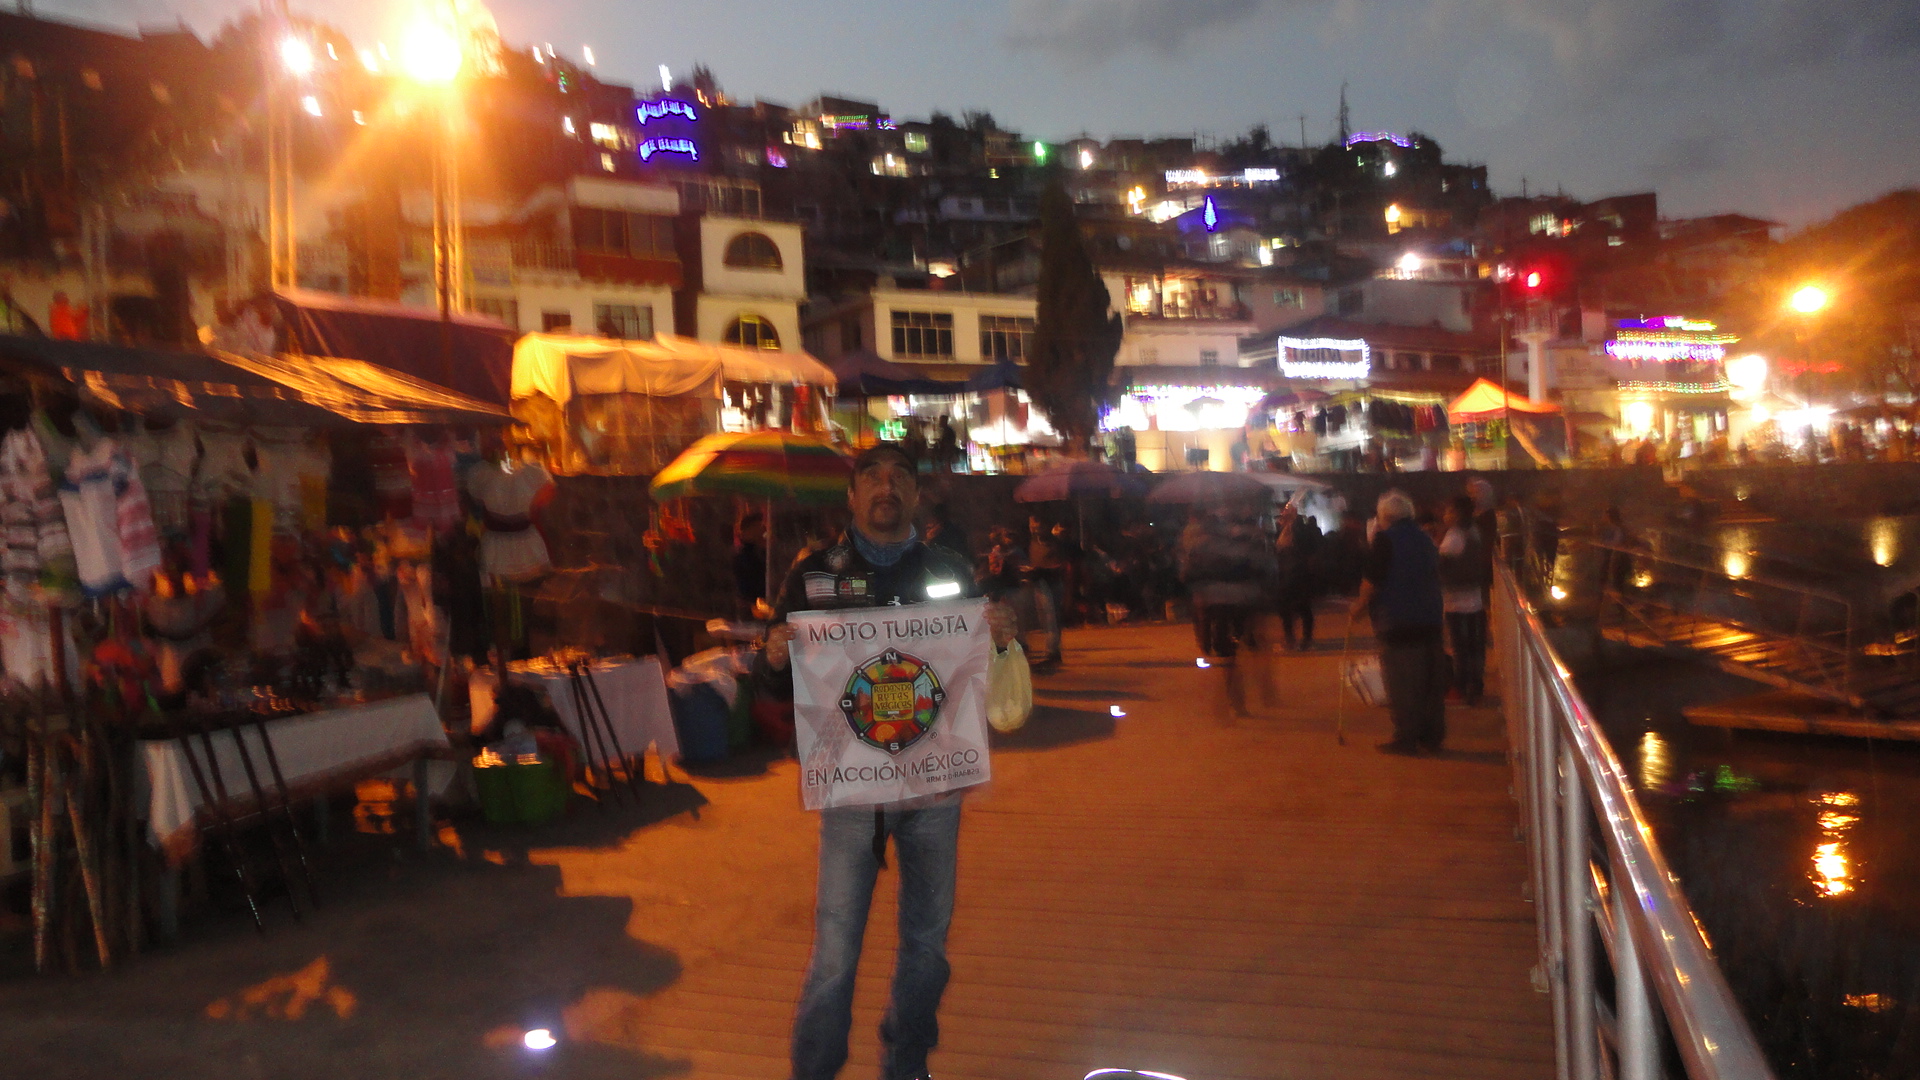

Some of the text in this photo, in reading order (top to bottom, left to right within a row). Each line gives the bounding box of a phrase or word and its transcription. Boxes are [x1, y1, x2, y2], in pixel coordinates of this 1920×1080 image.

[808, 614, 968, 642] MOTO TURISTA
[885, 652, 897, 661] N
[873, 684, 912, 694] RODANDO
[877, 691, 909, 702] RUTAS
[934, 693, 943, 702] E
[889, 742, 900, 751] S
[807, 749, 980, 787] EN ACCIÓN MÉXICO
